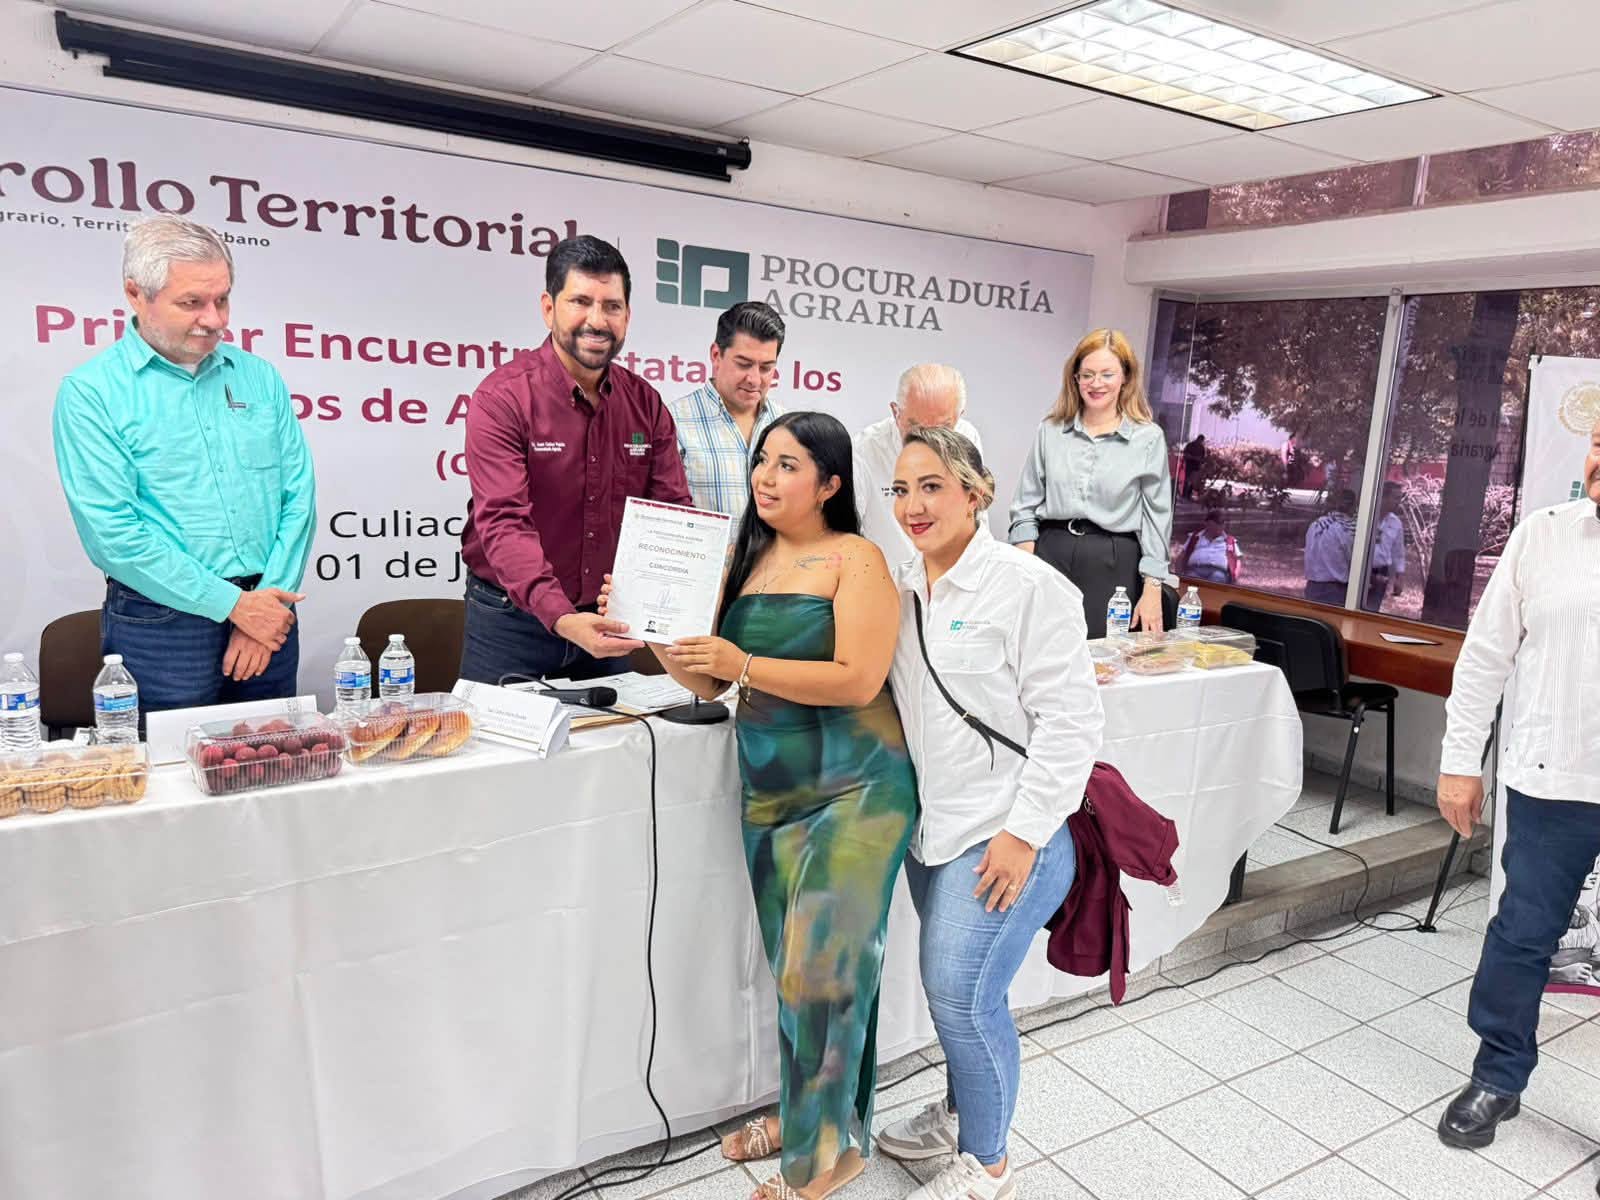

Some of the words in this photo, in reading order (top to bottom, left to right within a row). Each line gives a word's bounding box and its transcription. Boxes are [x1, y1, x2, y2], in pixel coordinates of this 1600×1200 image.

[760, 254, 1054, 314] PROCURADURÍA
[764, 288, 943, 331] AGRARIA
[793, 360, 842, 392] los
[361, 388, 428, 424] de
[330, 510, 463, 538] Culiac
[316, 553, 361, 581] 01
[385, 551, 438, 579] de
